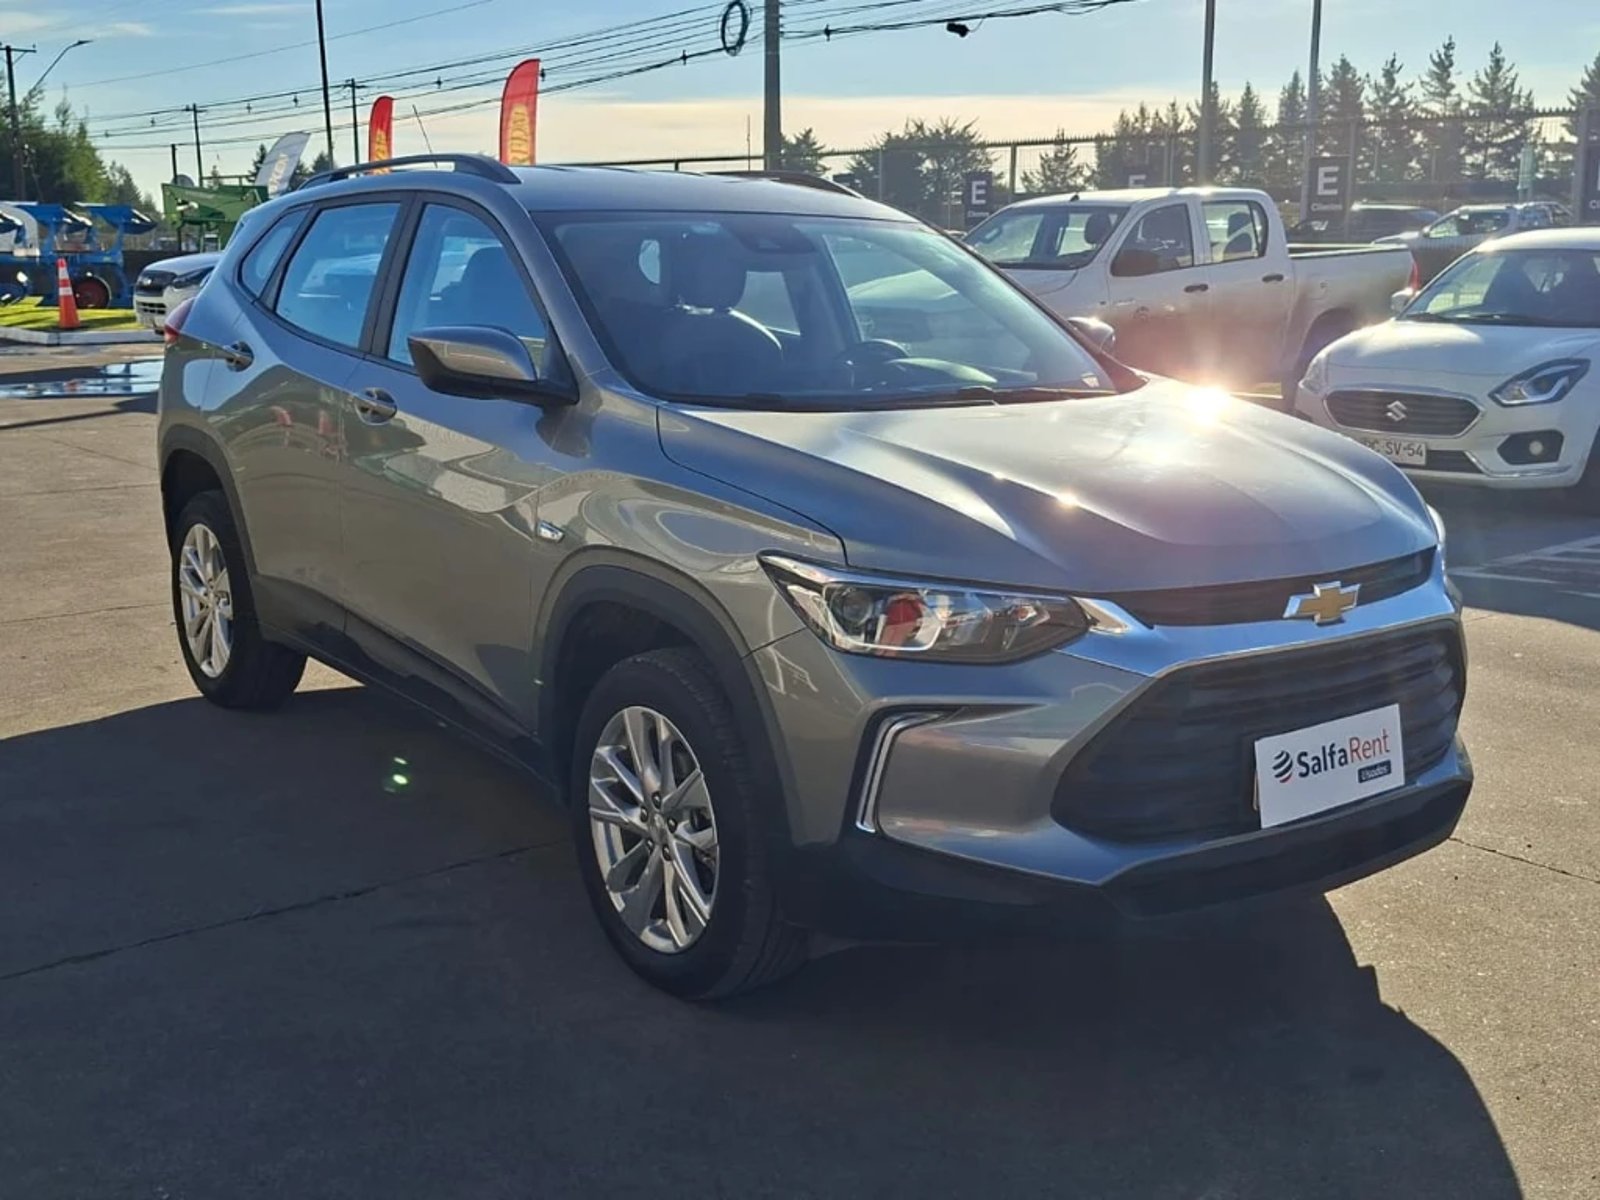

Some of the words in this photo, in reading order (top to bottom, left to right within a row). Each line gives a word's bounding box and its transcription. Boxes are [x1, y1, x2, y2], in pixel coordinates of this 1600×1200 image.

[971, 180, 987, 205] E
[1317, 166, 1340, 195] E
[1297, 728, 1390, 778] SalfaRent
